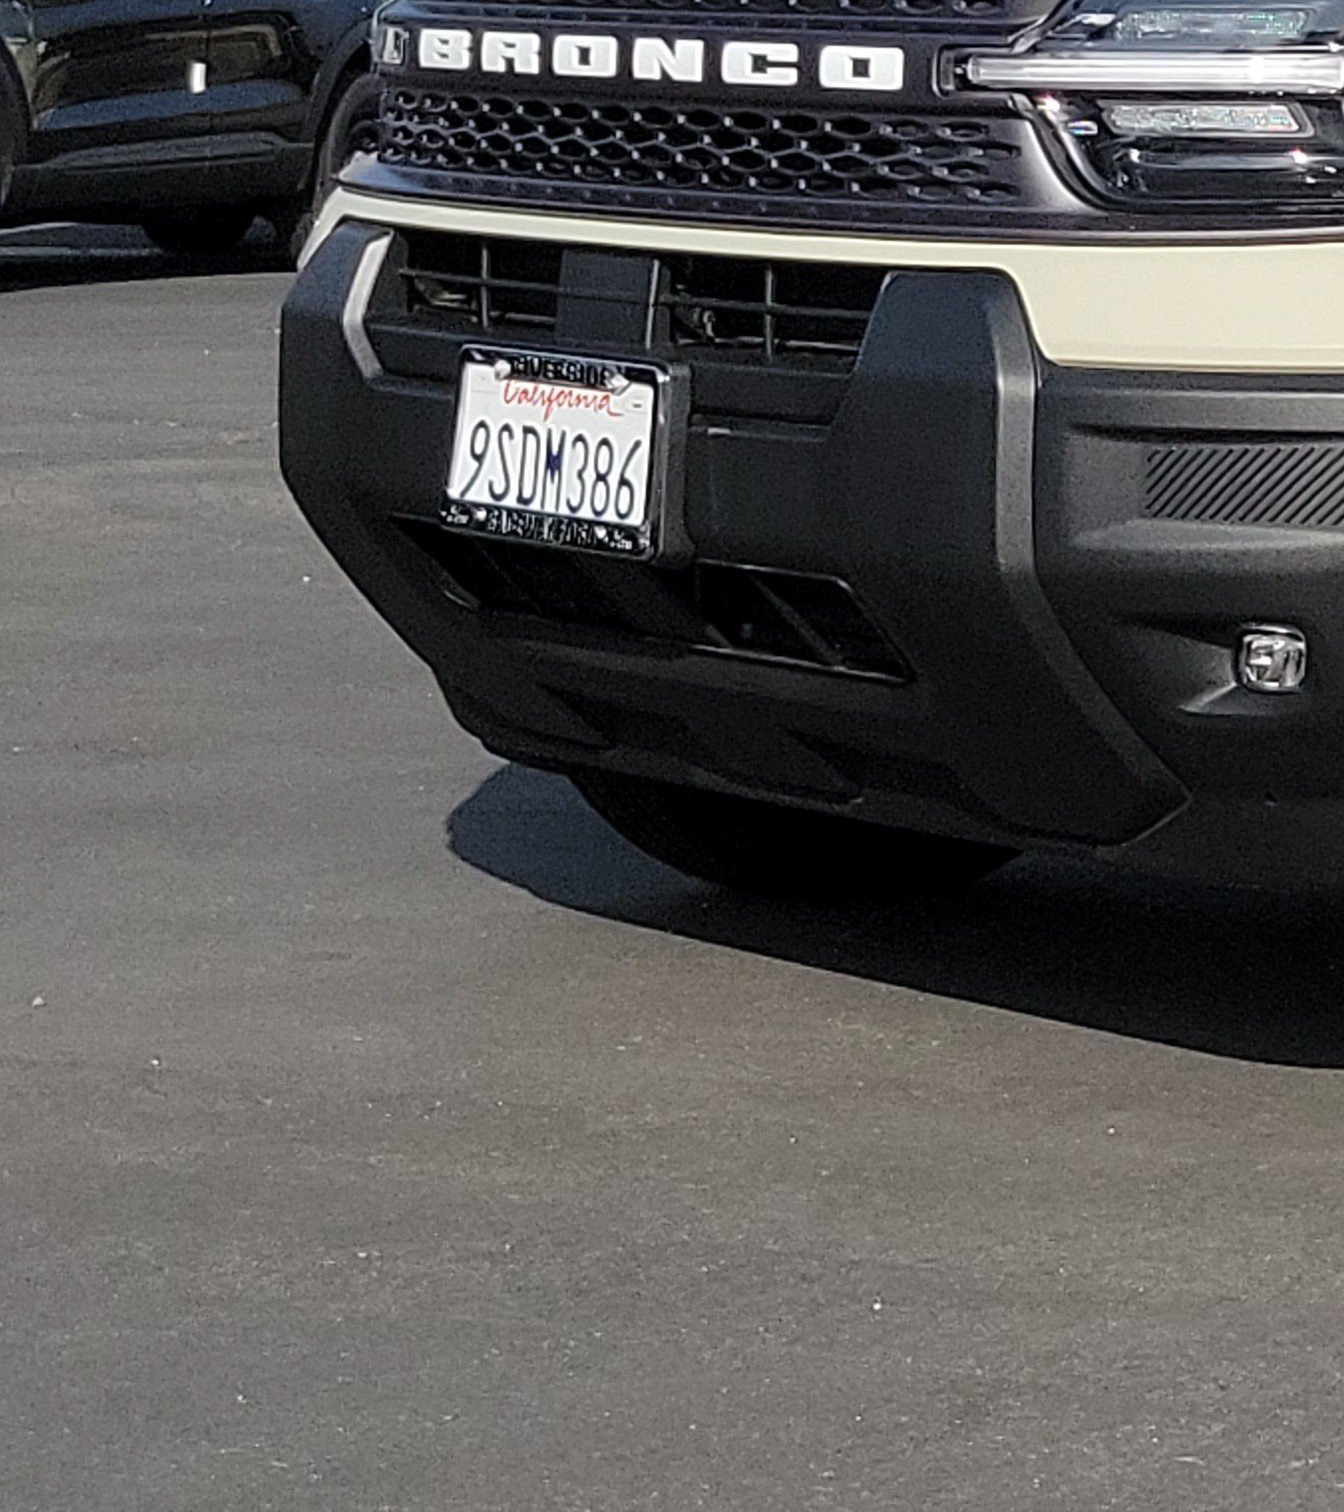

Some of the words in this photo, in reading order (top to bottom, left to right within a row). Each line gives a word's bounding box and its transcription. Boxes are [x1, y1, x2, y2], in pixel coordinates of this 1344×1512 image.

[418, 28, 904, 90] BRONCO
[503, 379, 624, 422] California
[460, 419, 642, 520] 9SDM386
